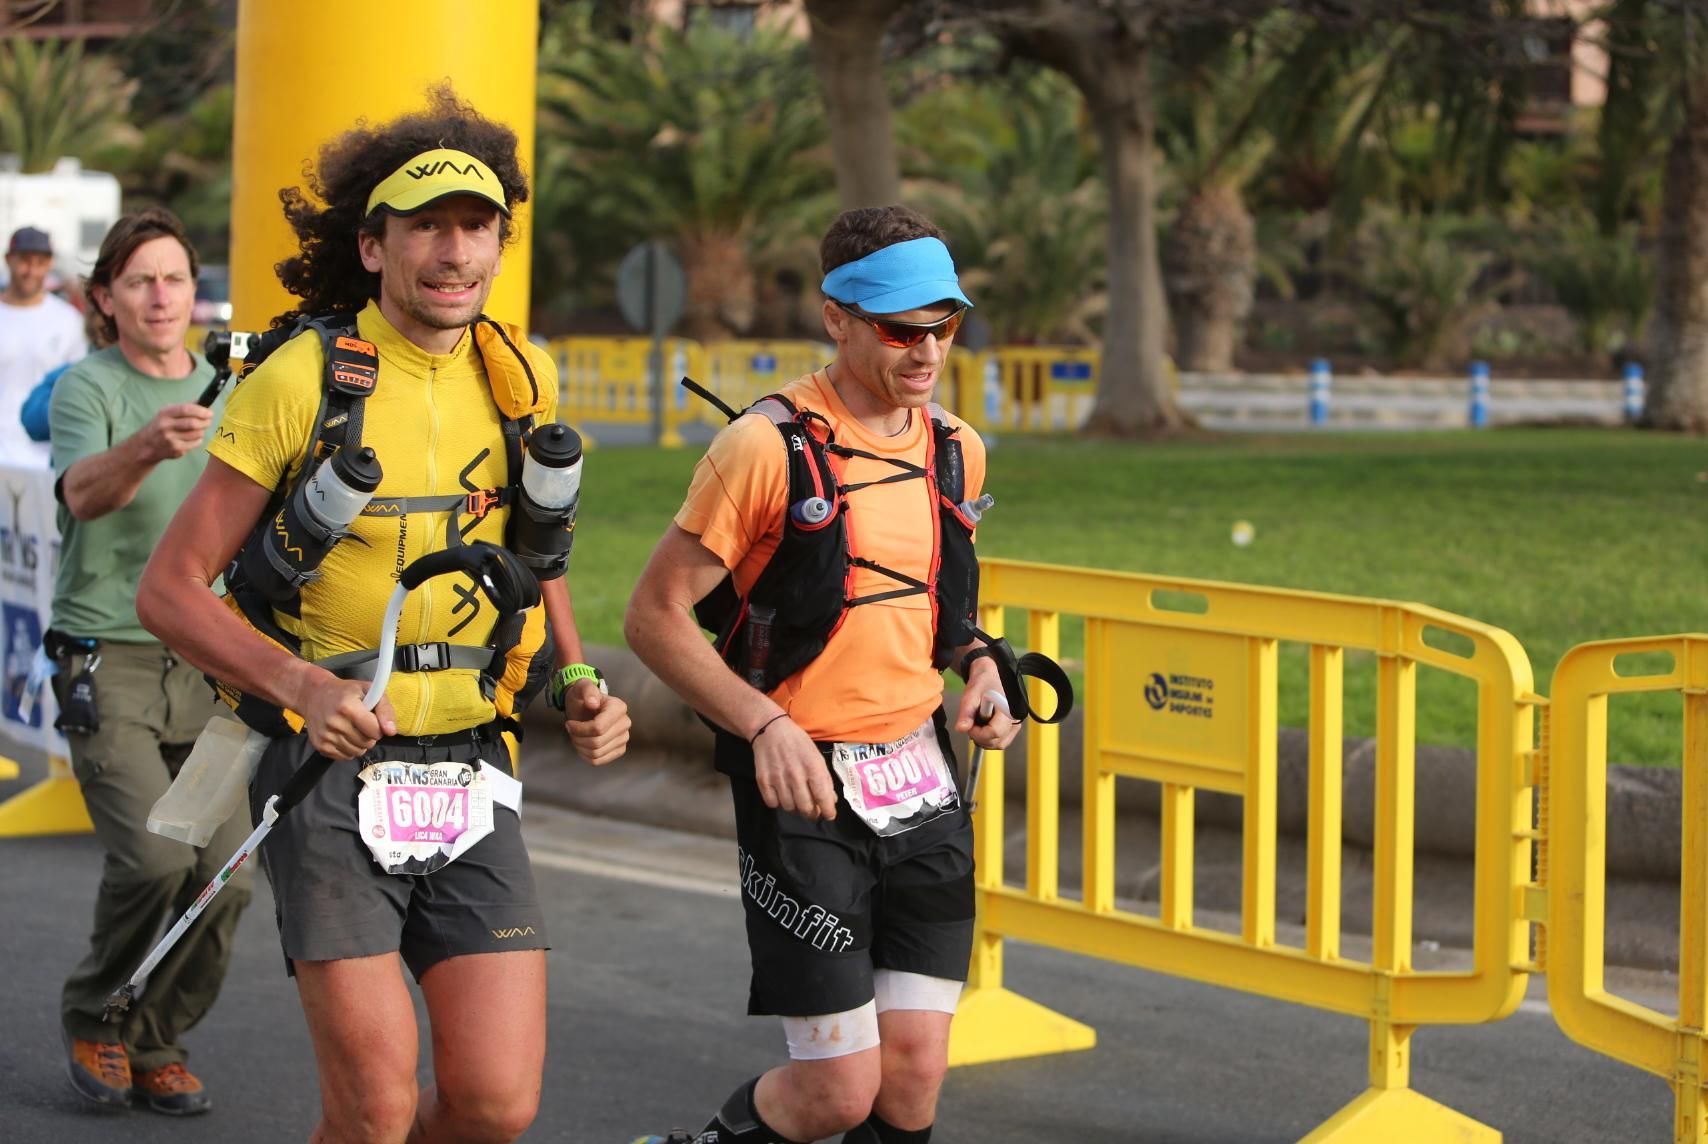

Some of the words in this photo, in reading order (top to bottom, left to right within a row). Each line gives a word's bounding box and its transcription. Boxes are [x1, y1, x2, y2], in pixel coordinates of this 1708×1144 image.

[406, 161, 484, 180] WAA
[395, 513, 407, 576] EQUIPMEN
[384, 766, 430, 786] TRANS
[430, 769, 448, 778] GRAN
[430, 777, 458, 786] CANARIA
[391, 790, 464, 830] 6004
[491, 926, 536, 939] WAA
